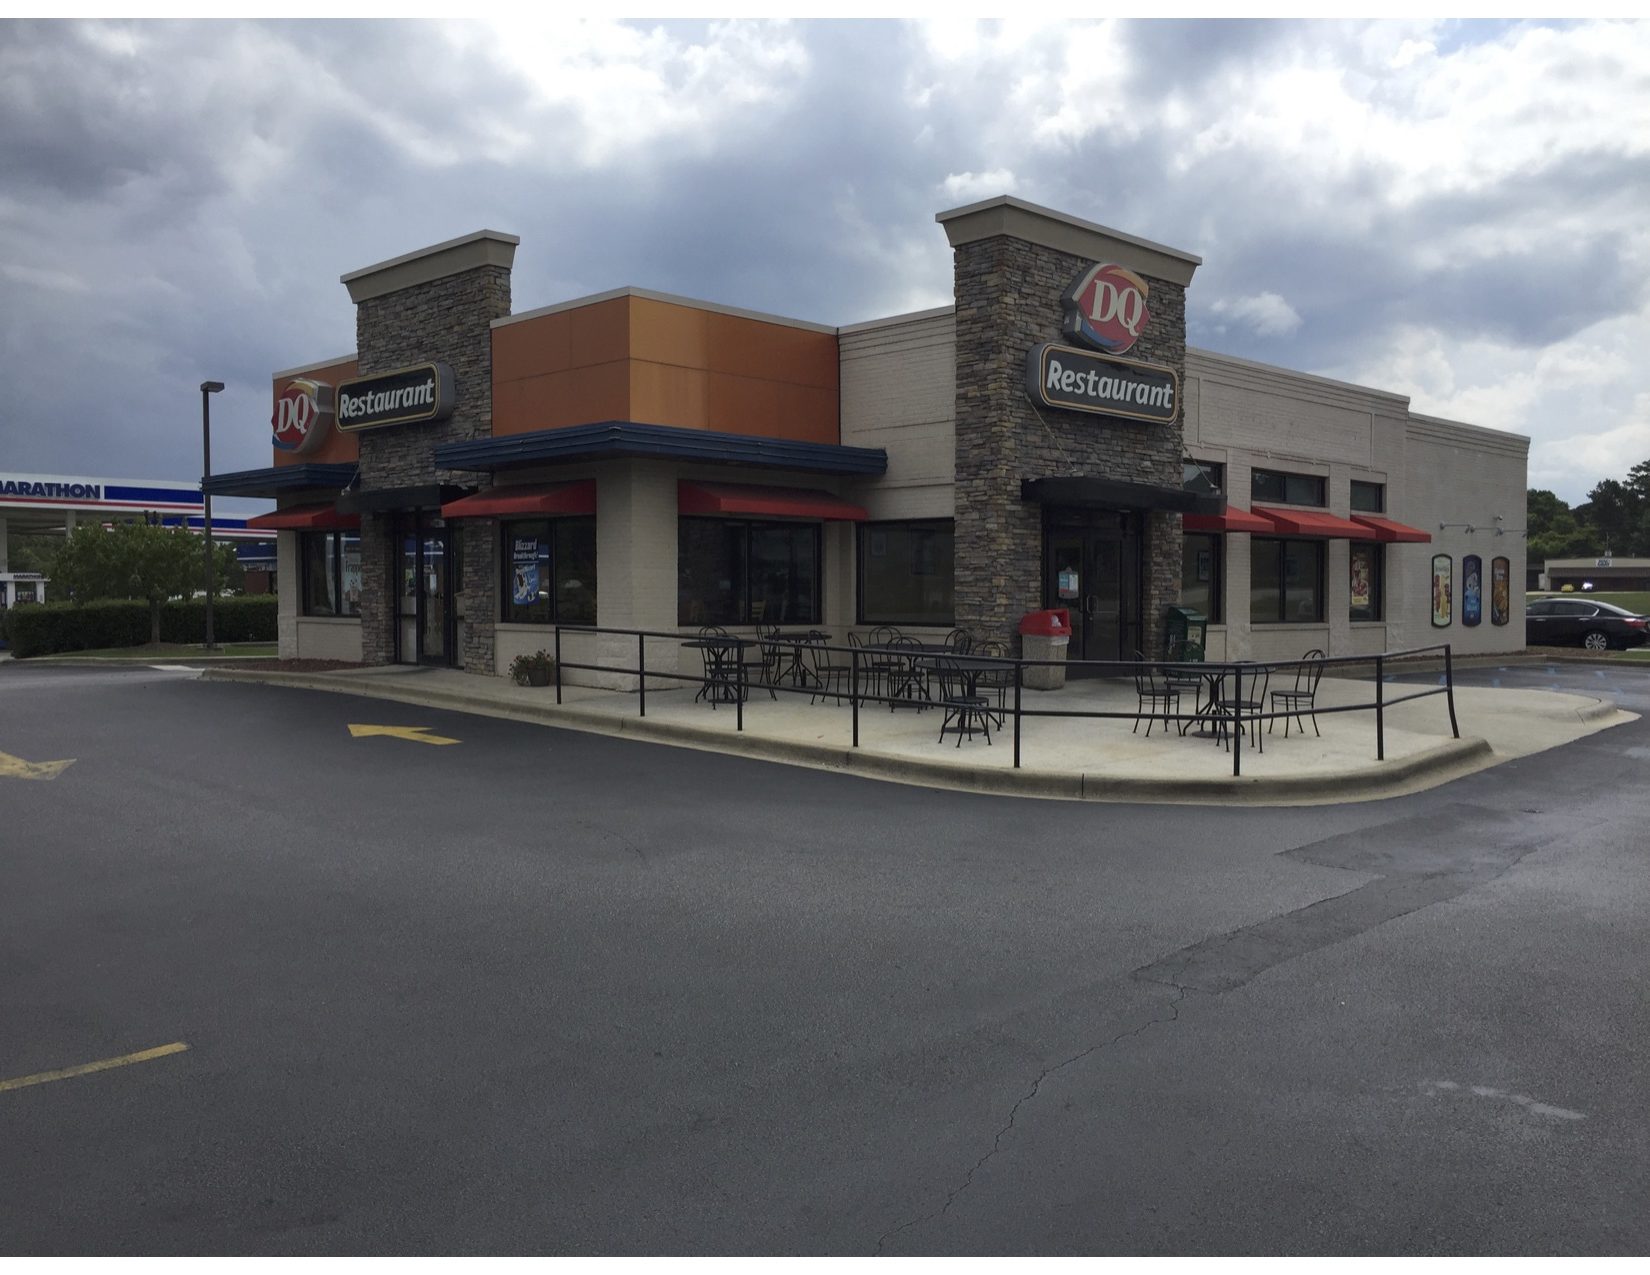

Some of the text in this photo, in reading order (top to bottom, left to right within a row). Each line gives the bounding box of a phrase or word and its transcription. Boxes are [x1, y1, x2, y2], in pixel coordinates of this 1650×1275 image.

[1089, 279, 1143, 337] DQ
[338, 378, 435, 419] Restaurant
[1046, 360, 1174, 409] Restaurant
[276, 393, 309, 435] DQ
